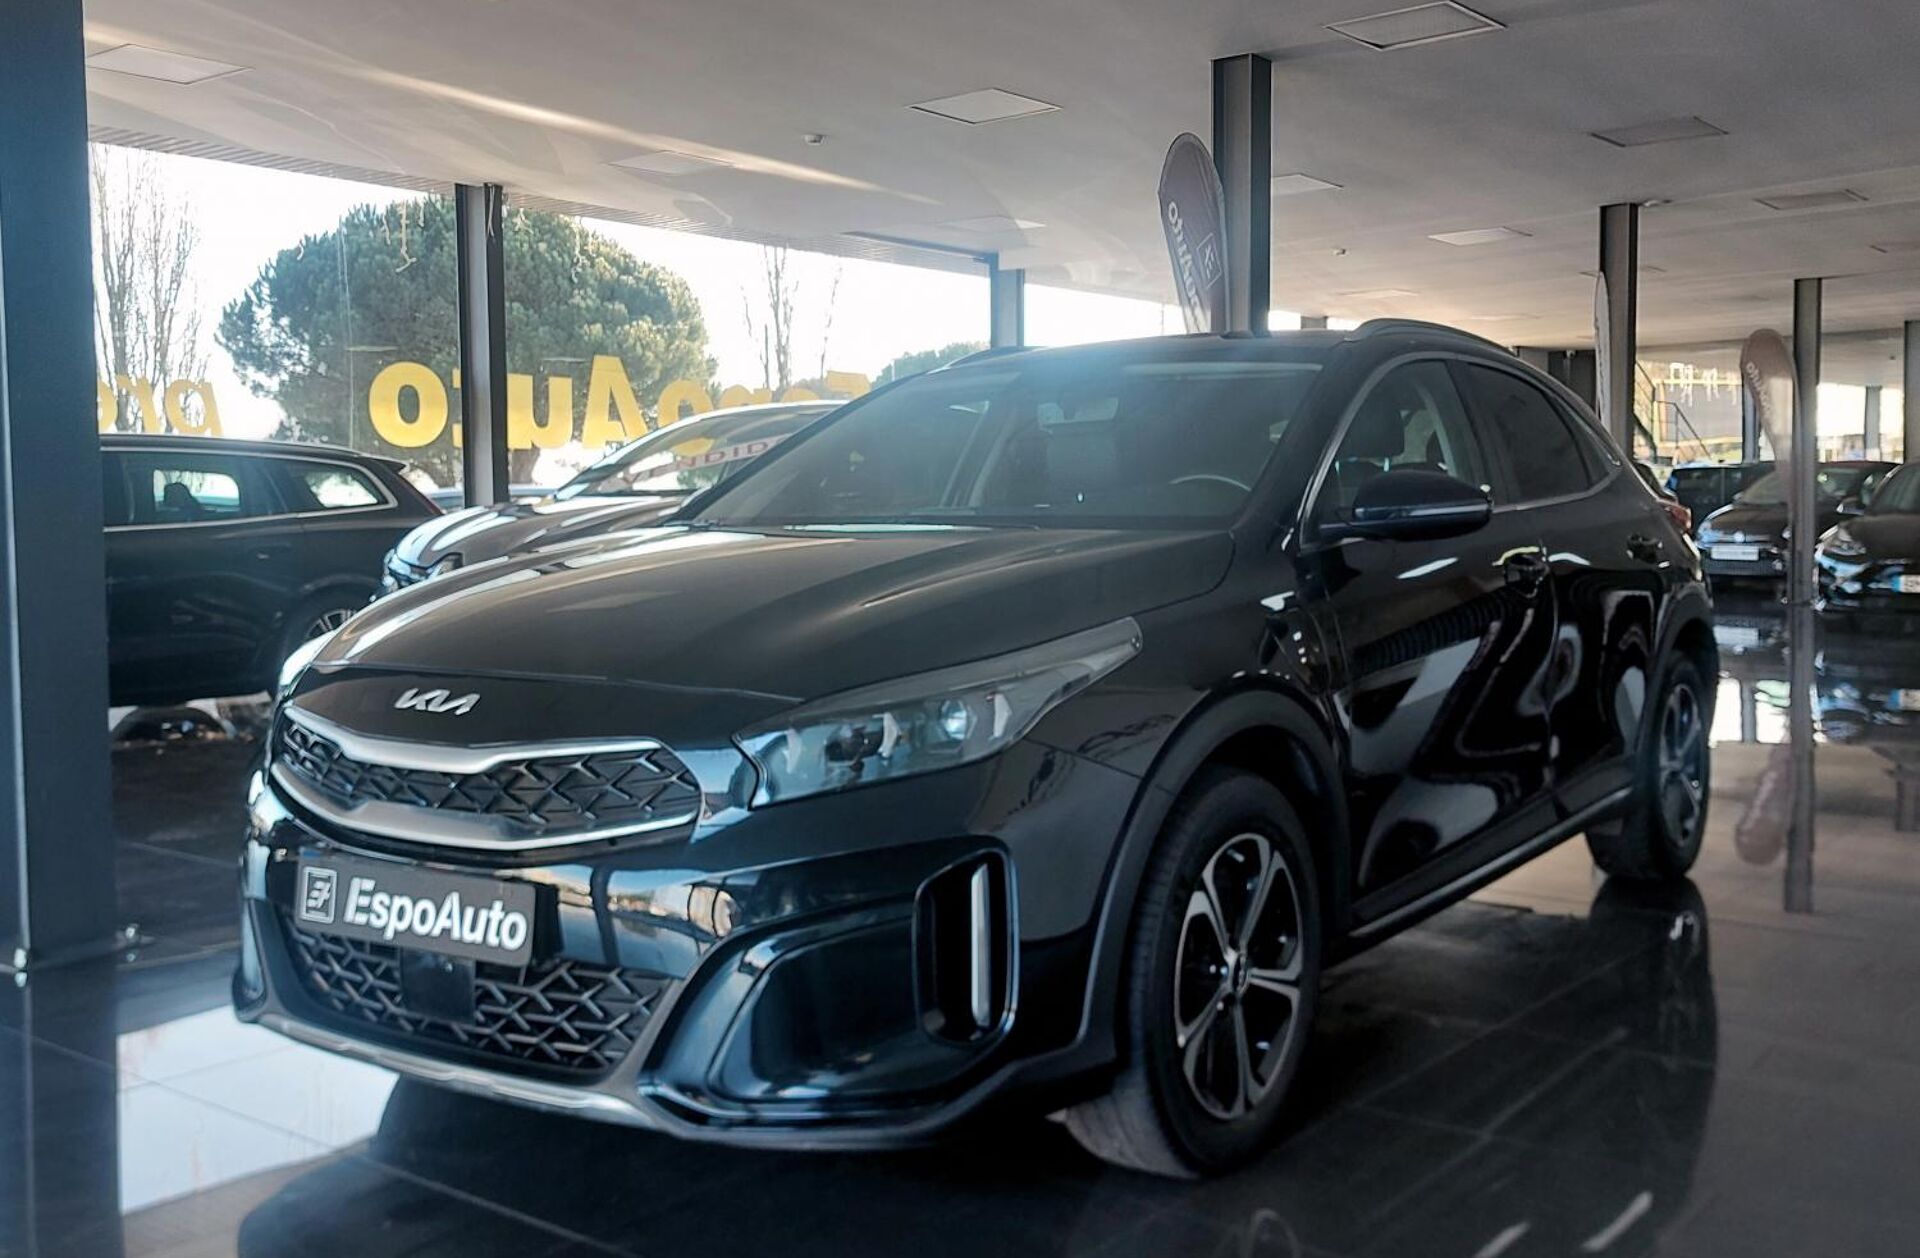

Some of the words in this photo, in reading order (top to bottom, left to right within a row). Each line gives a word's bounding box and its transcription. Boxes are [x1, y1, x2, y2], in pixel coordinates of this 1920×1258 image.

[622, 438, 784, 484] VENDID
[394, 687, 481, 716] KIA
[343, 876, 528, 951] EspoAuto
